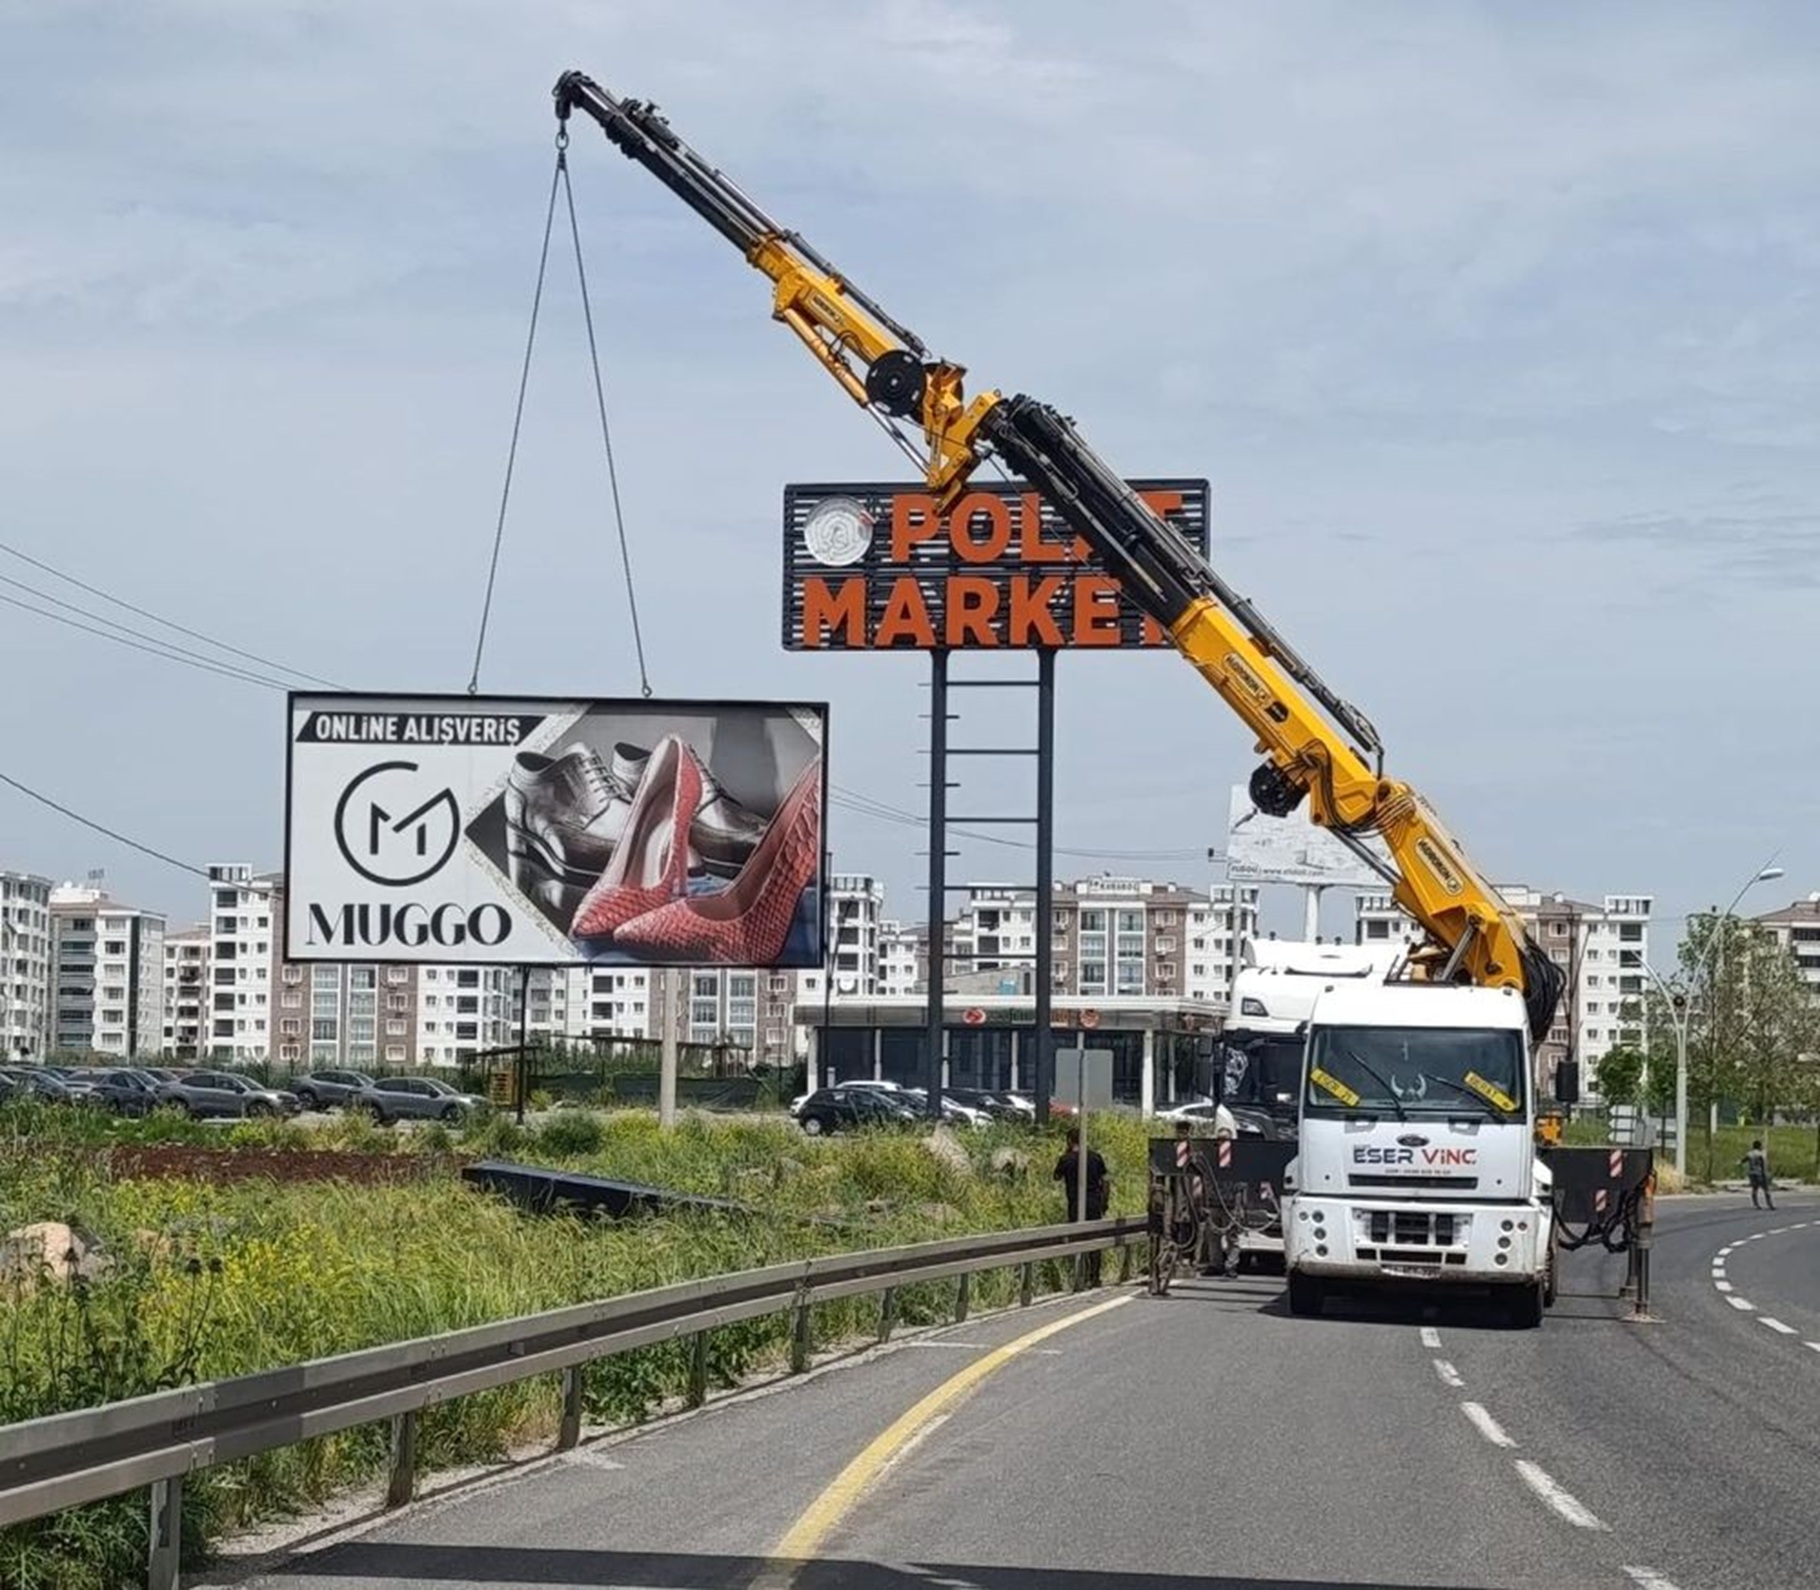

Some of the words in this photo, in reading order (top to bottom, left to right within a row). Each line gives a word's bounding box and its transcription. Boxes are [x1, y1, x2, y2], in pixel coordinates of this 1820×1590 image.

[802, 575, 1168, 648] MARKE
[305, 901, 513, 947] MUGGO
[1353, 1148, 1414, 1165] ESER
